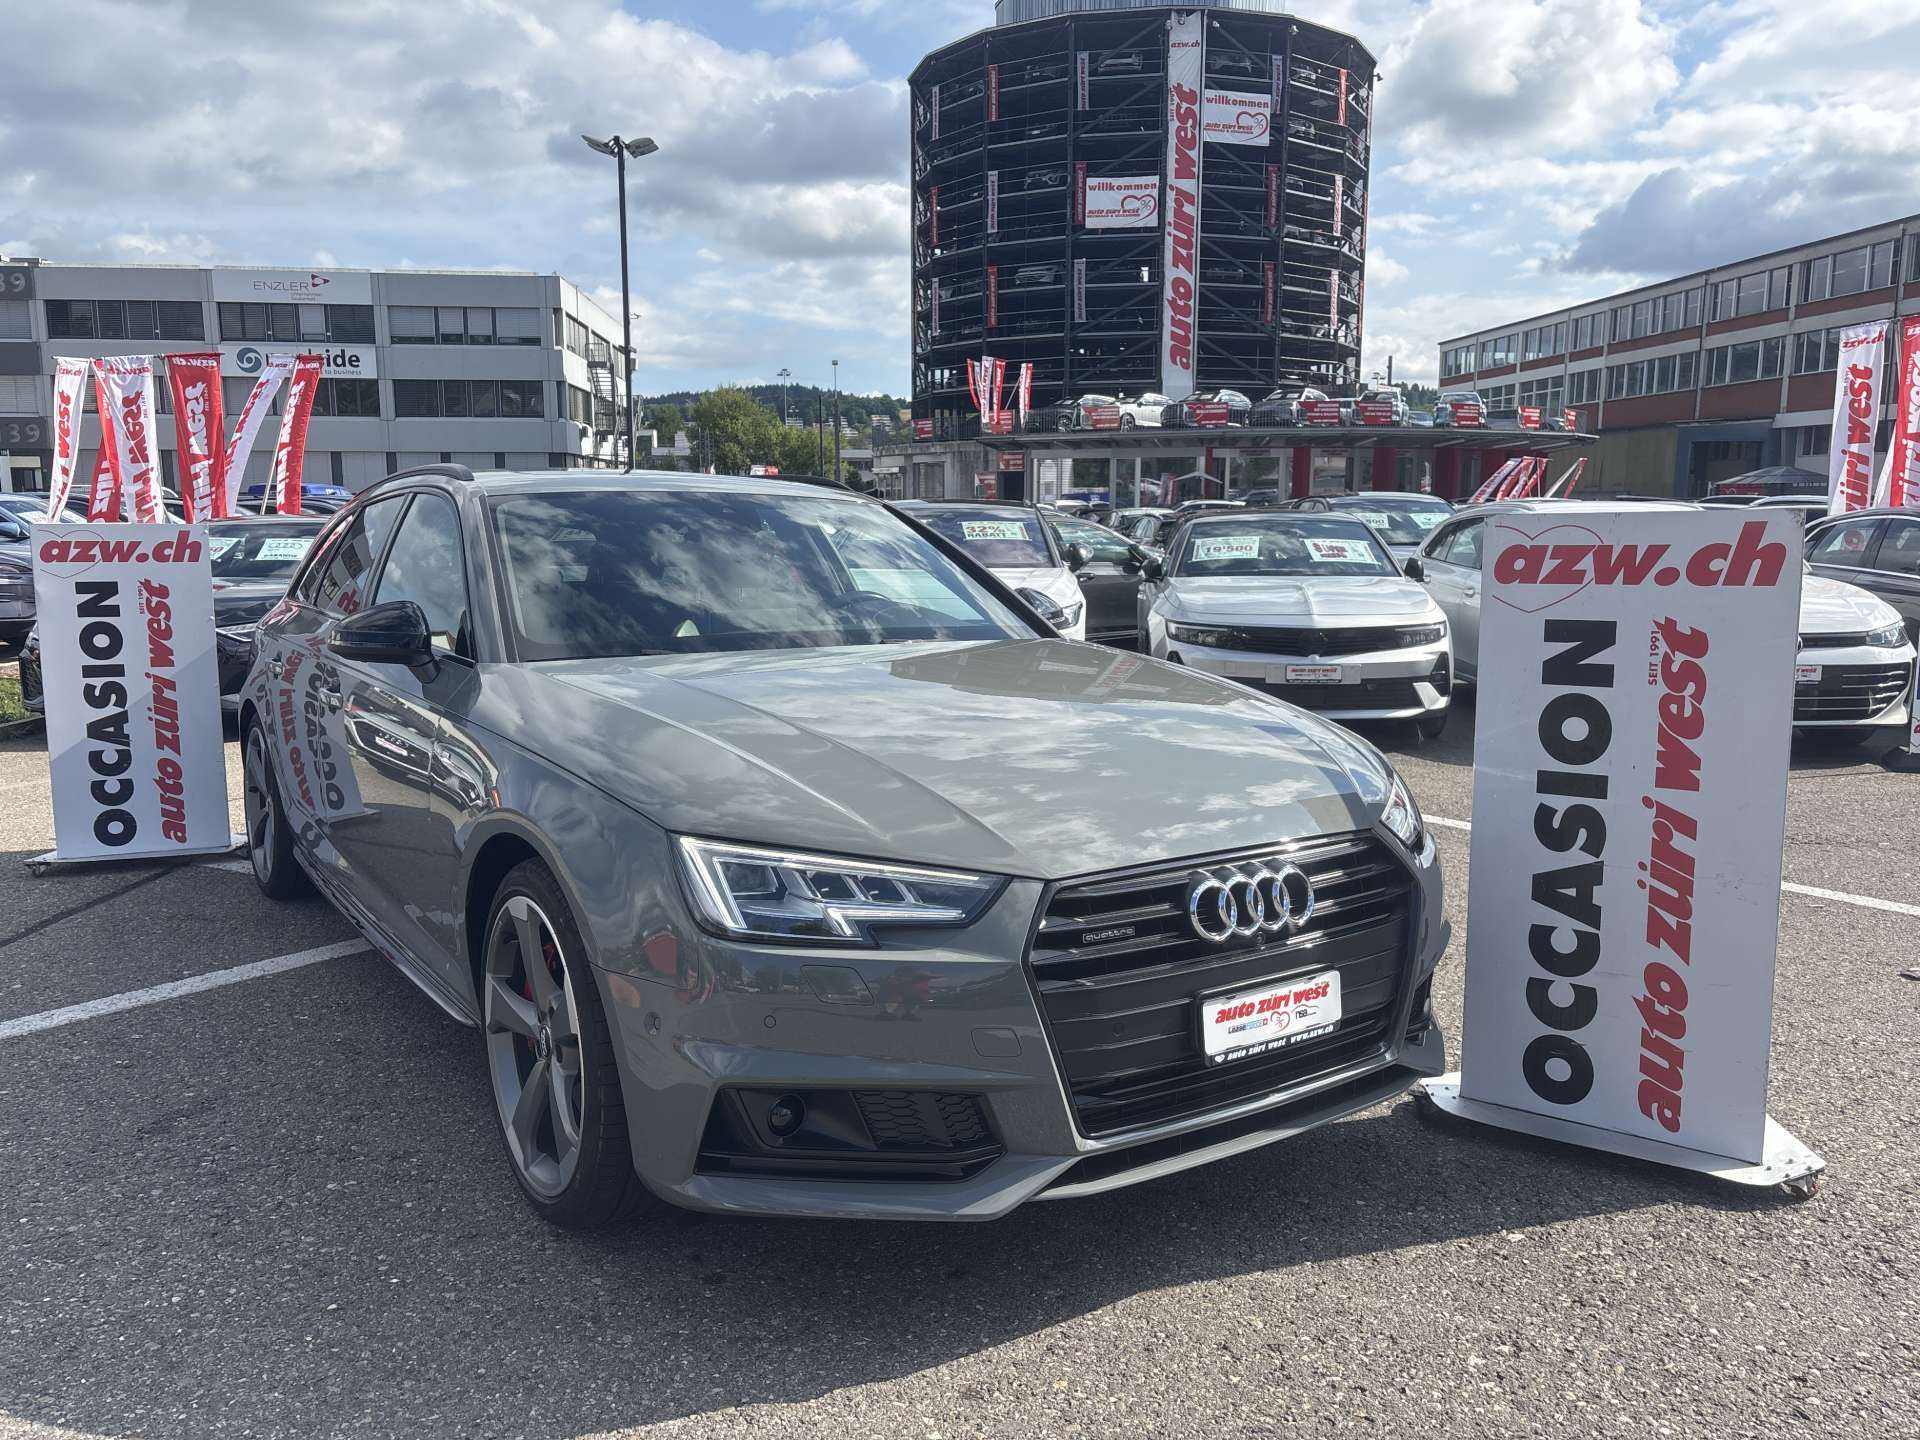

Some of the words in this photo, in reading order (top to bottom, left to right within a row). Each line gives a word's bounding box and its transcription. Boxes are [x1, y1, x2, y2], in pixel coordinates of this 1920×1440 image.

[1172, 82, 1198, 180] west
[1206, 95, 1269, 108] willkommen
[1088, 182, 1157, 192] willkommen
[1167, 184, 1196, 276] züri
[254, 280, 309, 292] ENZLER
[1167, 276, 1193, 370] auto
[8, 424, 40, 442] 39
[58, 390, 71, 458] west
[1848, 362, 1873, 444] west
[40, 530, 202, 563] azw.ch
[1492, 520, 1788, 587] azw.ch
[137, 578, 174, 668] west
[1650, 631, 1660, 656] 1991
[1648, 662, 1658, 686] SEIT
[1652, 616, 1709, 792] west
[75, 581, 138, 847] OCCASION
[144, 672, 182, 756] züri
[151, 760, 188, 844] auto
[1522, 618, 1618, 1105] OCCASION
[1636, 795, 1698, 966] züri
[1086, 928, 1134, 942] quattro
[1215, 1002, 1256, 1024] auto
[1257, 990, 1292, 1014] züri
[1293, 982, 1330, 1005] west
[1227, 1050, 1246, 1060] auto
[1248, 1044, 1266, 1054] züri
[1268, 1038, 1286, 1050] west
[1290, 1025, 1334, 1043] www.azw.ch
[1632, 962, 1689, 1134] auto
